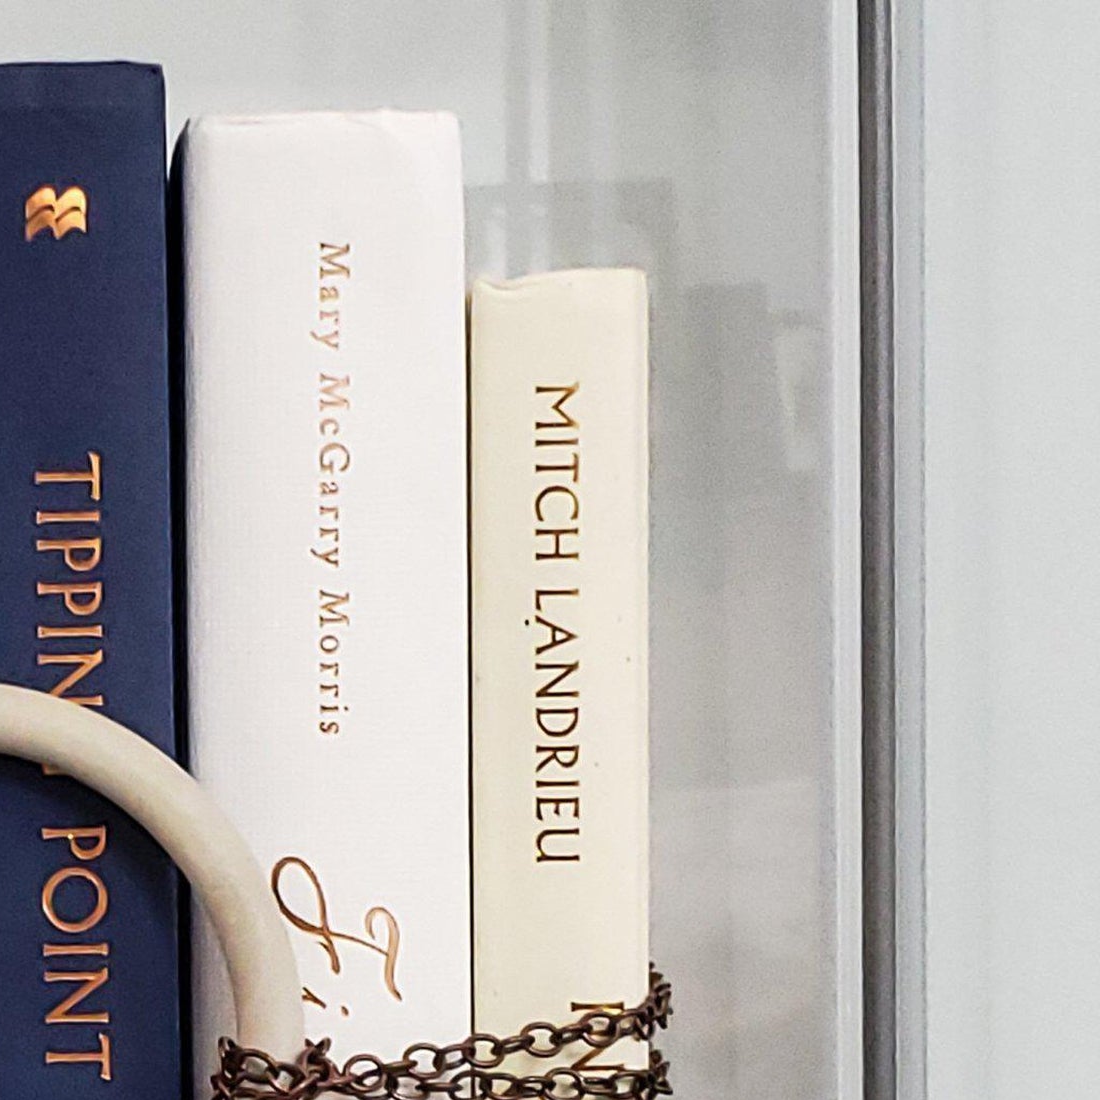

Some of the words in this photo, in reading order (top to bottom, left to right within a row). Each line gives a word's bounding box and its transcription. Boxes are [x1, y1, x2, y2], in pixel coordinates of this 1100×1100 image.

[311, 242, 351, 350] Mary
[311, 372, 351, 567] McGarry
[534, 381, 580, 562] MITCH
[35, 451, 104, 776] TIPPIN
[318, 589, 350, 735] Morris
[534, 588, 581, 864] LANDRIEU
[41, 825, 112, 1081] POINT
